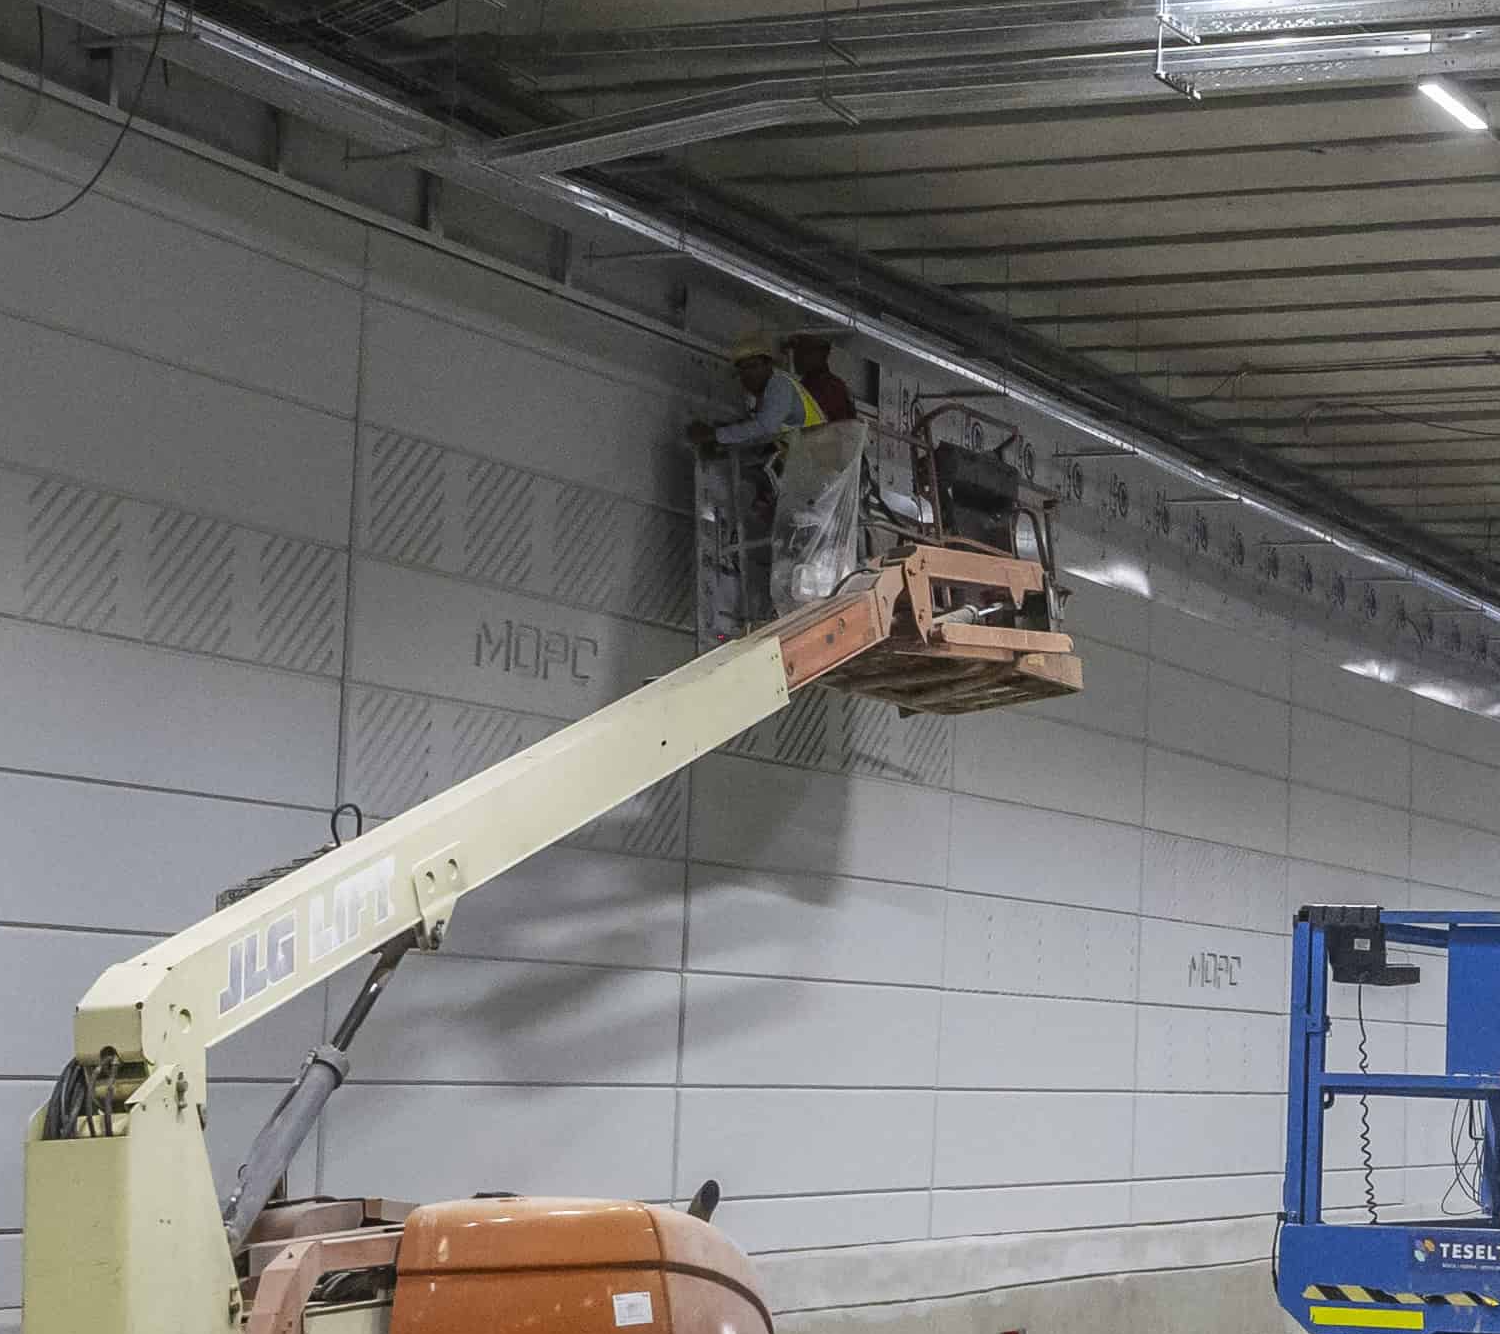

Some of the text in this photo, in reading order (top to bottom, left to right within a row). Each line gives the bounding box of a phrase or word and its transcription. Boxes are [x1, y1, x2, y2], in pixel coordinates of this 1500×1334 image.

[474, 619, 598, 681] MOPC
[218, 856, 396, 1018] JLG LIFT
[1188, 952, 1241, 989] MOPC
